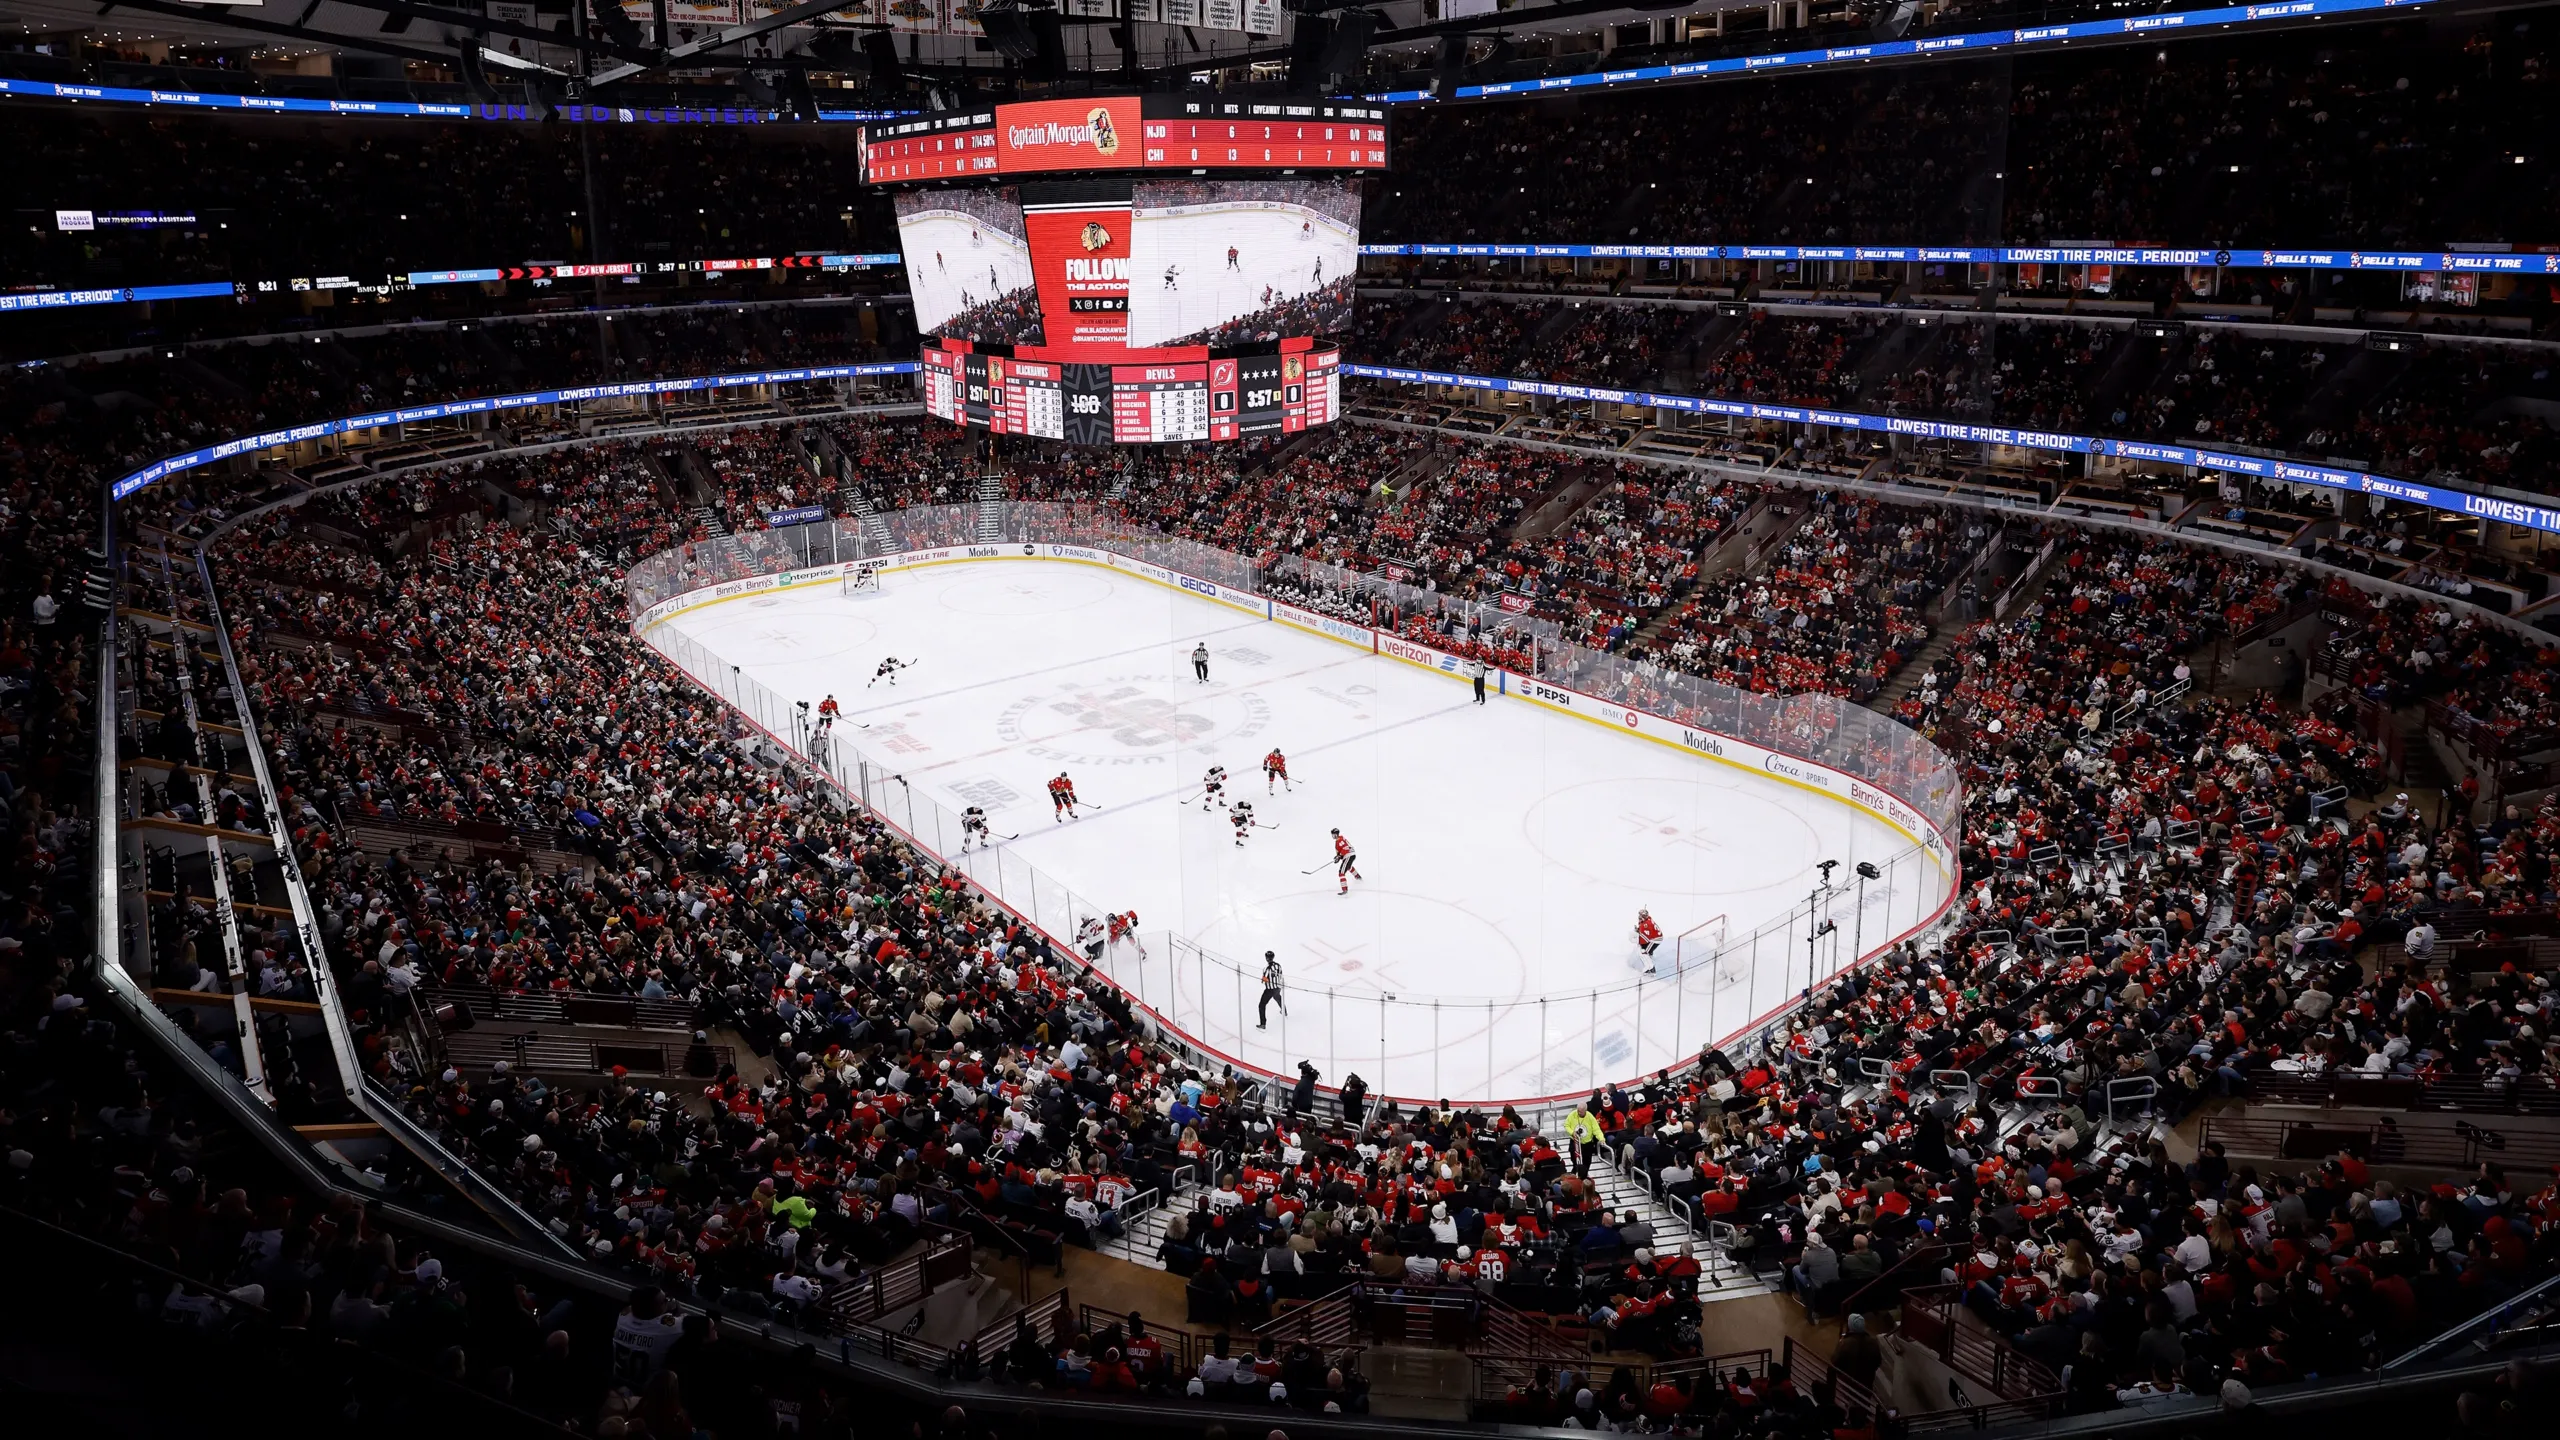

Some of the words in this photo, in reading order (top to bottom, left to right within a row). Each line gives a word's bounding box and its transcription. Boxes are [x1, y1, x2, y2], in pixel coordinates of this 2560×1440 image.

[2257, 6, 2287, 15] BELLE
[2291, 4, 2314, 12] TIRE
[2134, 19, 2161, 28] BELLE
[2164, 17, 2184, 25] TIRE
[2023, 30, 2047, 38] BELLE
[2047, 28, 2068, 36] TIRE
[1924, 40, 1944, 48] BELLE
[481, 104, 610, 121] UNED
[644, 107, 759, 124] CENTER
[1187, 104, 1199, 112] PEN
[1225, 104, 1238, 113] HITS
[1253, 105, 1280, 114] GIVEAWAY
[1286, 106, 1312, 115] TAKEAWAY
[1009, 123, 1045, 149] Captain
[1044, 122, 1095, 146] Morgan
[1147, 126, 1165, 138] NJD
[1230, 126, 1234, 138] 6
[1265, 127, 1269, 138] 3
[1297, 128, 1302, 139] 4
[1326, 128, 1332, 140] 10
[1148, 149, 1163, 161] CHI
[1192, 149, 1197, 160] 0
[1229, 149, 1236, 160] 13
[1265, 149, 1270, 161] 6
[1327, 150, 1331, 161] 7
[1592, 246, 1624, 255] LOWEST
[1625, 246, 1643, 255] TIRE
[1645, 247, 1671, 257] PRICE,
[2008, 250, 2059, 260] LOWEST
[2062, 250, 2091, 261] TIRE
[2095, 250, 2138, 264] PRICE,
[2274, 255, 2307, 263] BELLE
[2310, 256, 2332, 264] TIRE
[2361, 256, 2395, 265] BELLE
[2398, 257, 2423, 265] TIRE
[2454, 258, 2491, 267] BELLE
[2495, 259, 2522, 267] TIRE
[603, 264, 629, 274] JERSEY
[659, 263, 675, 271] 3:57
[711, 260, 738, 269] CHICAGO
[1065, 258, 1129, 280] FOLLOW
[258, 280, 277, 291] 9:21
[19, 295, 40, 306] TIRE
[39, 293, 69, 305] PRICE,
[1146, 369, 1176, 380] DEVILS
[559, 388, 595, 400] LOWEST
[595, 386, 620, 396] TIRE
[623, 384, 653, 398] PRICE,
[1290, 387, 1297, 401] 0
[1508, 381, 1539, 392] LOWEST
[1541, 384, 1559, 394] TIRE
[1220, 394, 1228, 409] 0
[1247, 389, 1272, 408] 3:57
[1760, 409, 1782, 417] BELLE
[1784, 411, 1800, 419] TIRE
[1291, 418, 1297, 429] 7
[1220, 426, 1230, 437] 10
[1887, 419, 1937, 436] LOWEST
[1939, 424, 1967, 438] TIRE
[1972, 427, 2013, 444] PRICE,
[213, 440, 242, 458] LOWEST
[241, 437, 258, 450] TIRE
[2128, 447, 2159, 456] BELLE
[2162, 450, 2184, 459] TIRE
[2205, 456, 2237, 467] BELLE
[2239, 461, 2262, 471] TIRE
[2286, 467, 2320, 480] BELLE
[2323, 473, 2348, 484] TIRE
[2372, 481, 2403, 495] BELLE
[2405, 488, 2428, 500] TIRE
[785, 510, 822, 521] HYUNDAI
[2466, 496, 2536, 523] LOWEST
[907, 553, 930, 562] BELLE
[968, 547, 998, 557] Modelo
[1064, 548, 1097, 559] FANDUEL
[1140, 566, 1166, 579] UNITED
[1389, 567, 1403, 577] CIBC
[1180, 575, 1216, 597] GEICO
[666, 596, 688, 613] GTL
[1222, 590, 1260, 609] ticketmaster
[1504, 596, 1522, 608] CIBC
[1283, 610, 1302, 621] BELLE
[1303, 615, 1317, 626] TIRE
[1383, 640, 1432, 665] verizon
[1537, 686, 1570, 705] PEPSI
[1602, 707, 1623, 719] BMO
[1684, 730, 1723, 756] Modelo
[1765, 754, 1800, 776] Circa
[1806, 772, 1828, 786] SPORTS
[976, 780, 1020, 801] BUD
[1101, 1190, 1114, 1209] 13
[1478, 1261, 1504, 1282] 98
